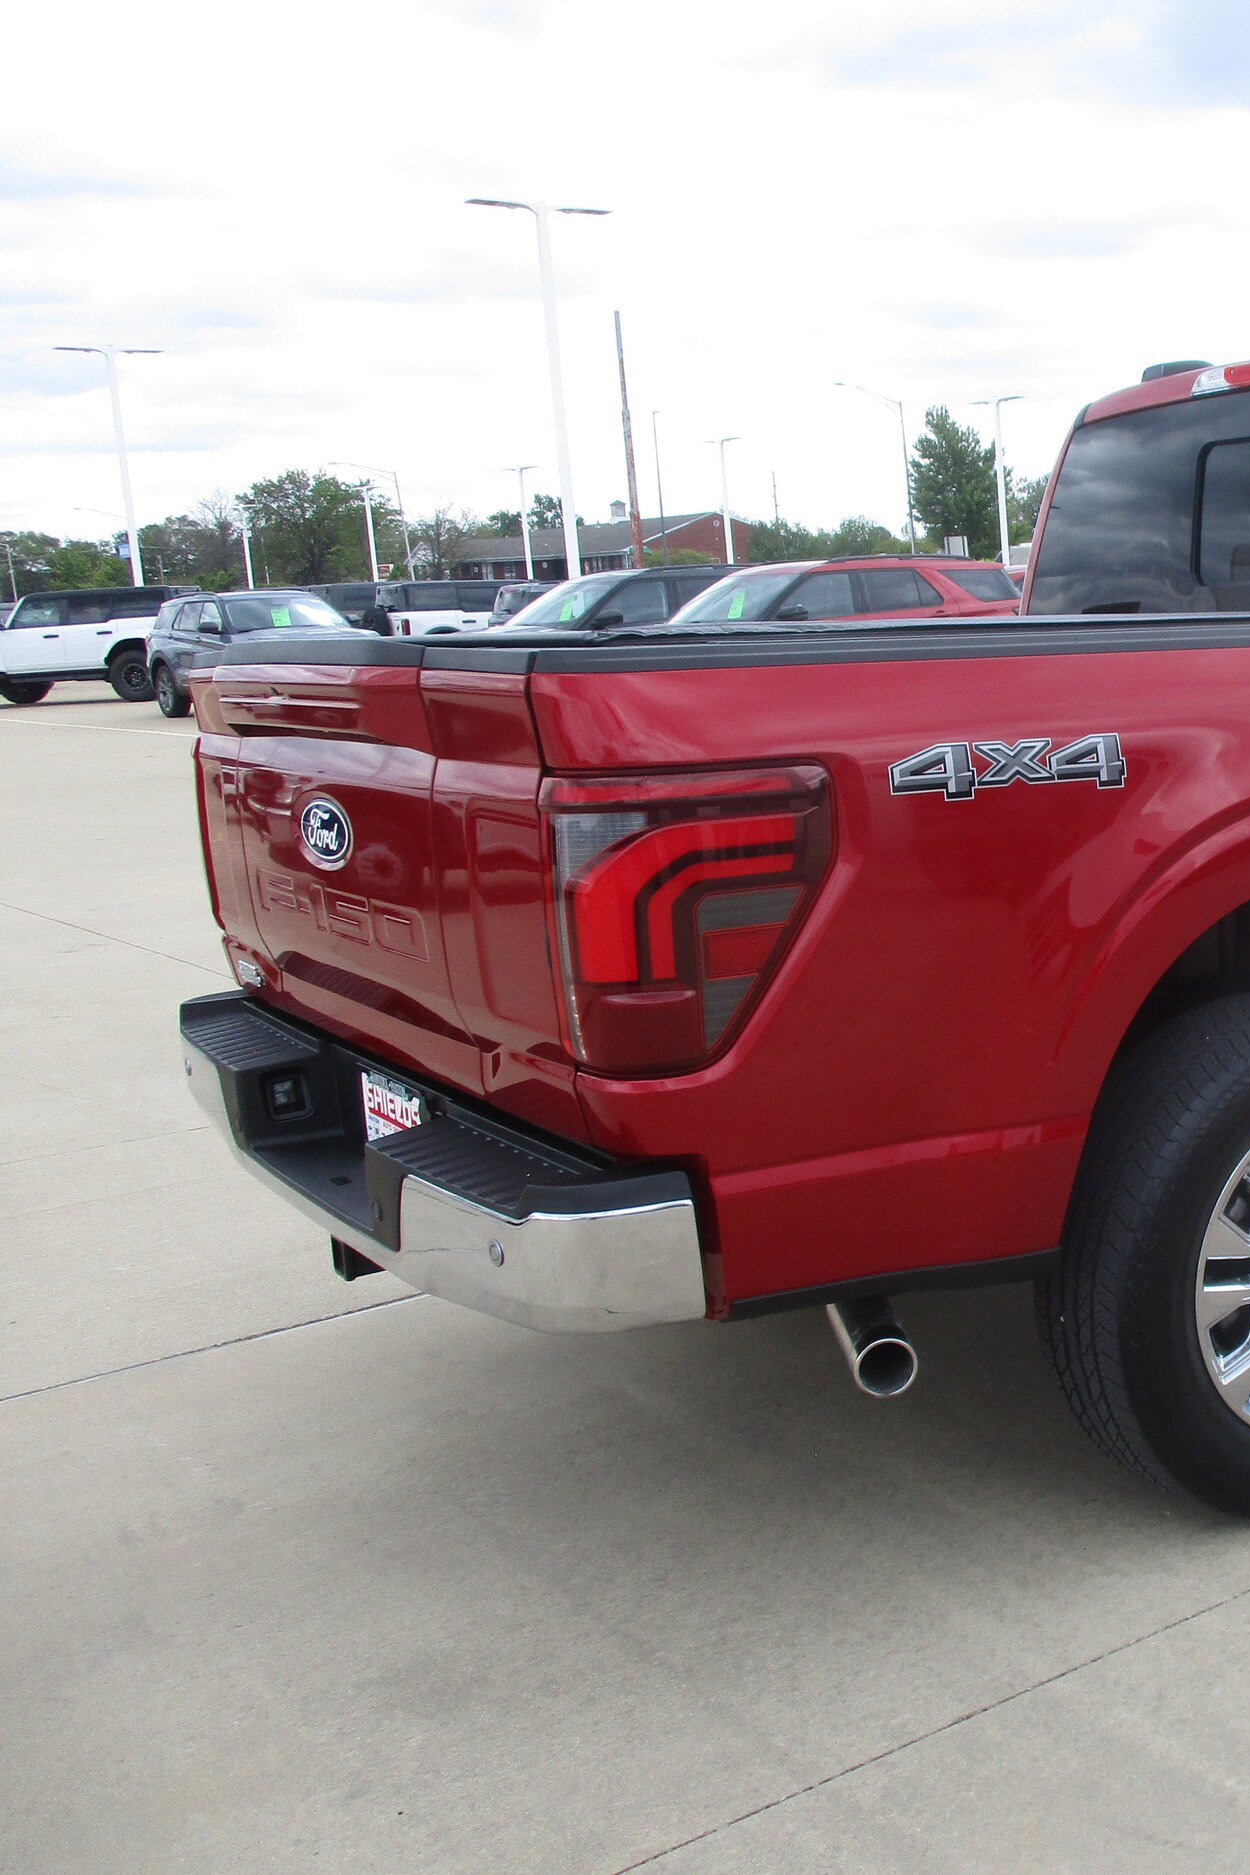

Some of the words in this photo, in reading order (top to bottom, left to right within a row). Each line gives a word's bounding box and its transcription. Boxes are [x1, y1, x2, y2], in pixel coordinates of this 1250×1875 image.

[308, 808, 339, 851] Ford
[257, 868, 430, 963] F-150
[366, 1082, 421, 1129] SHIELDS
